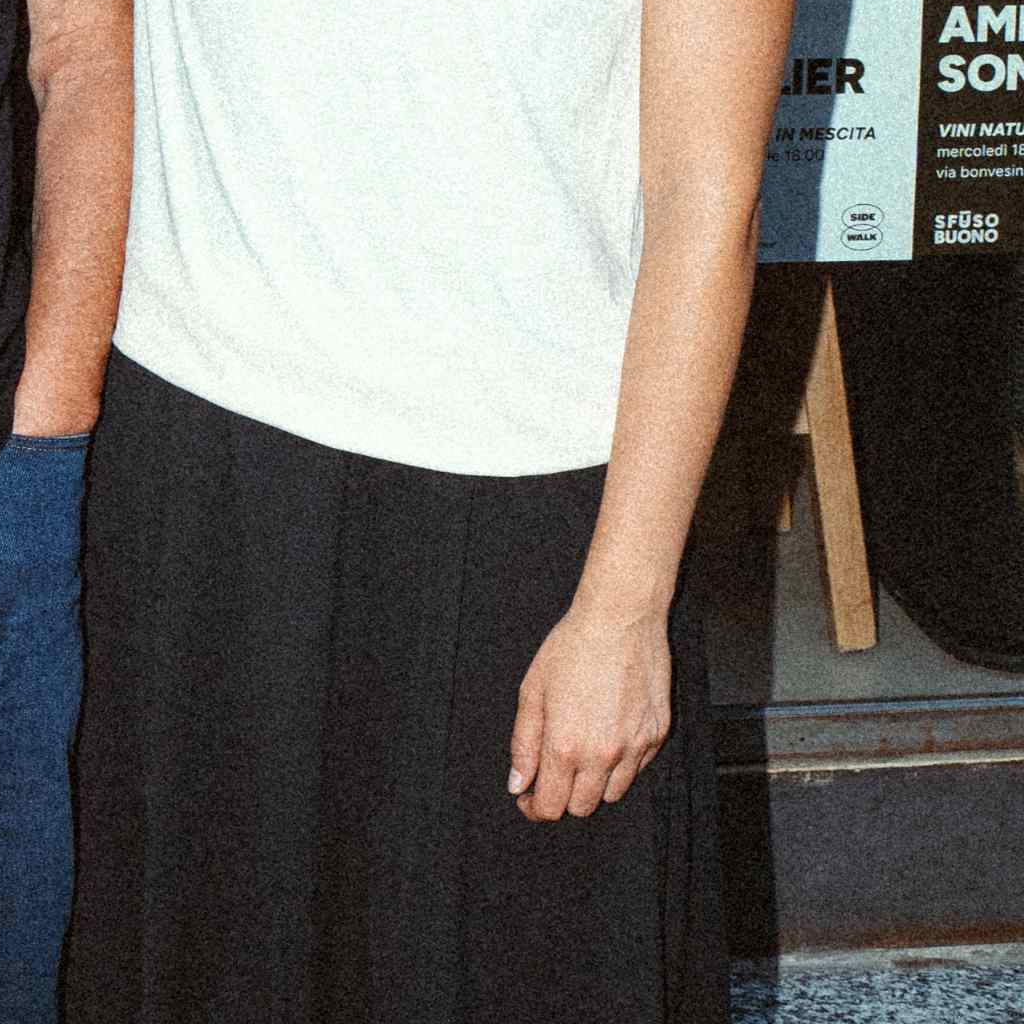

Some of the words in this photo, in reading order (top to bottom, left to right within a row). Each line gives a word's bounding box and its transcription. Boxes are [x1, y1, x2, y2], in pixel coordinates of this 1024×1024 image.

[799, 126, 878, 141] MESCITA
[939, 123, 977, 139] VINI
[935, 165, 957, 180] via
[850, 212, 876, 222] SIDE
[847, 233, 878, 242] WALK
[933, 228, 1000, 245] BUONO
